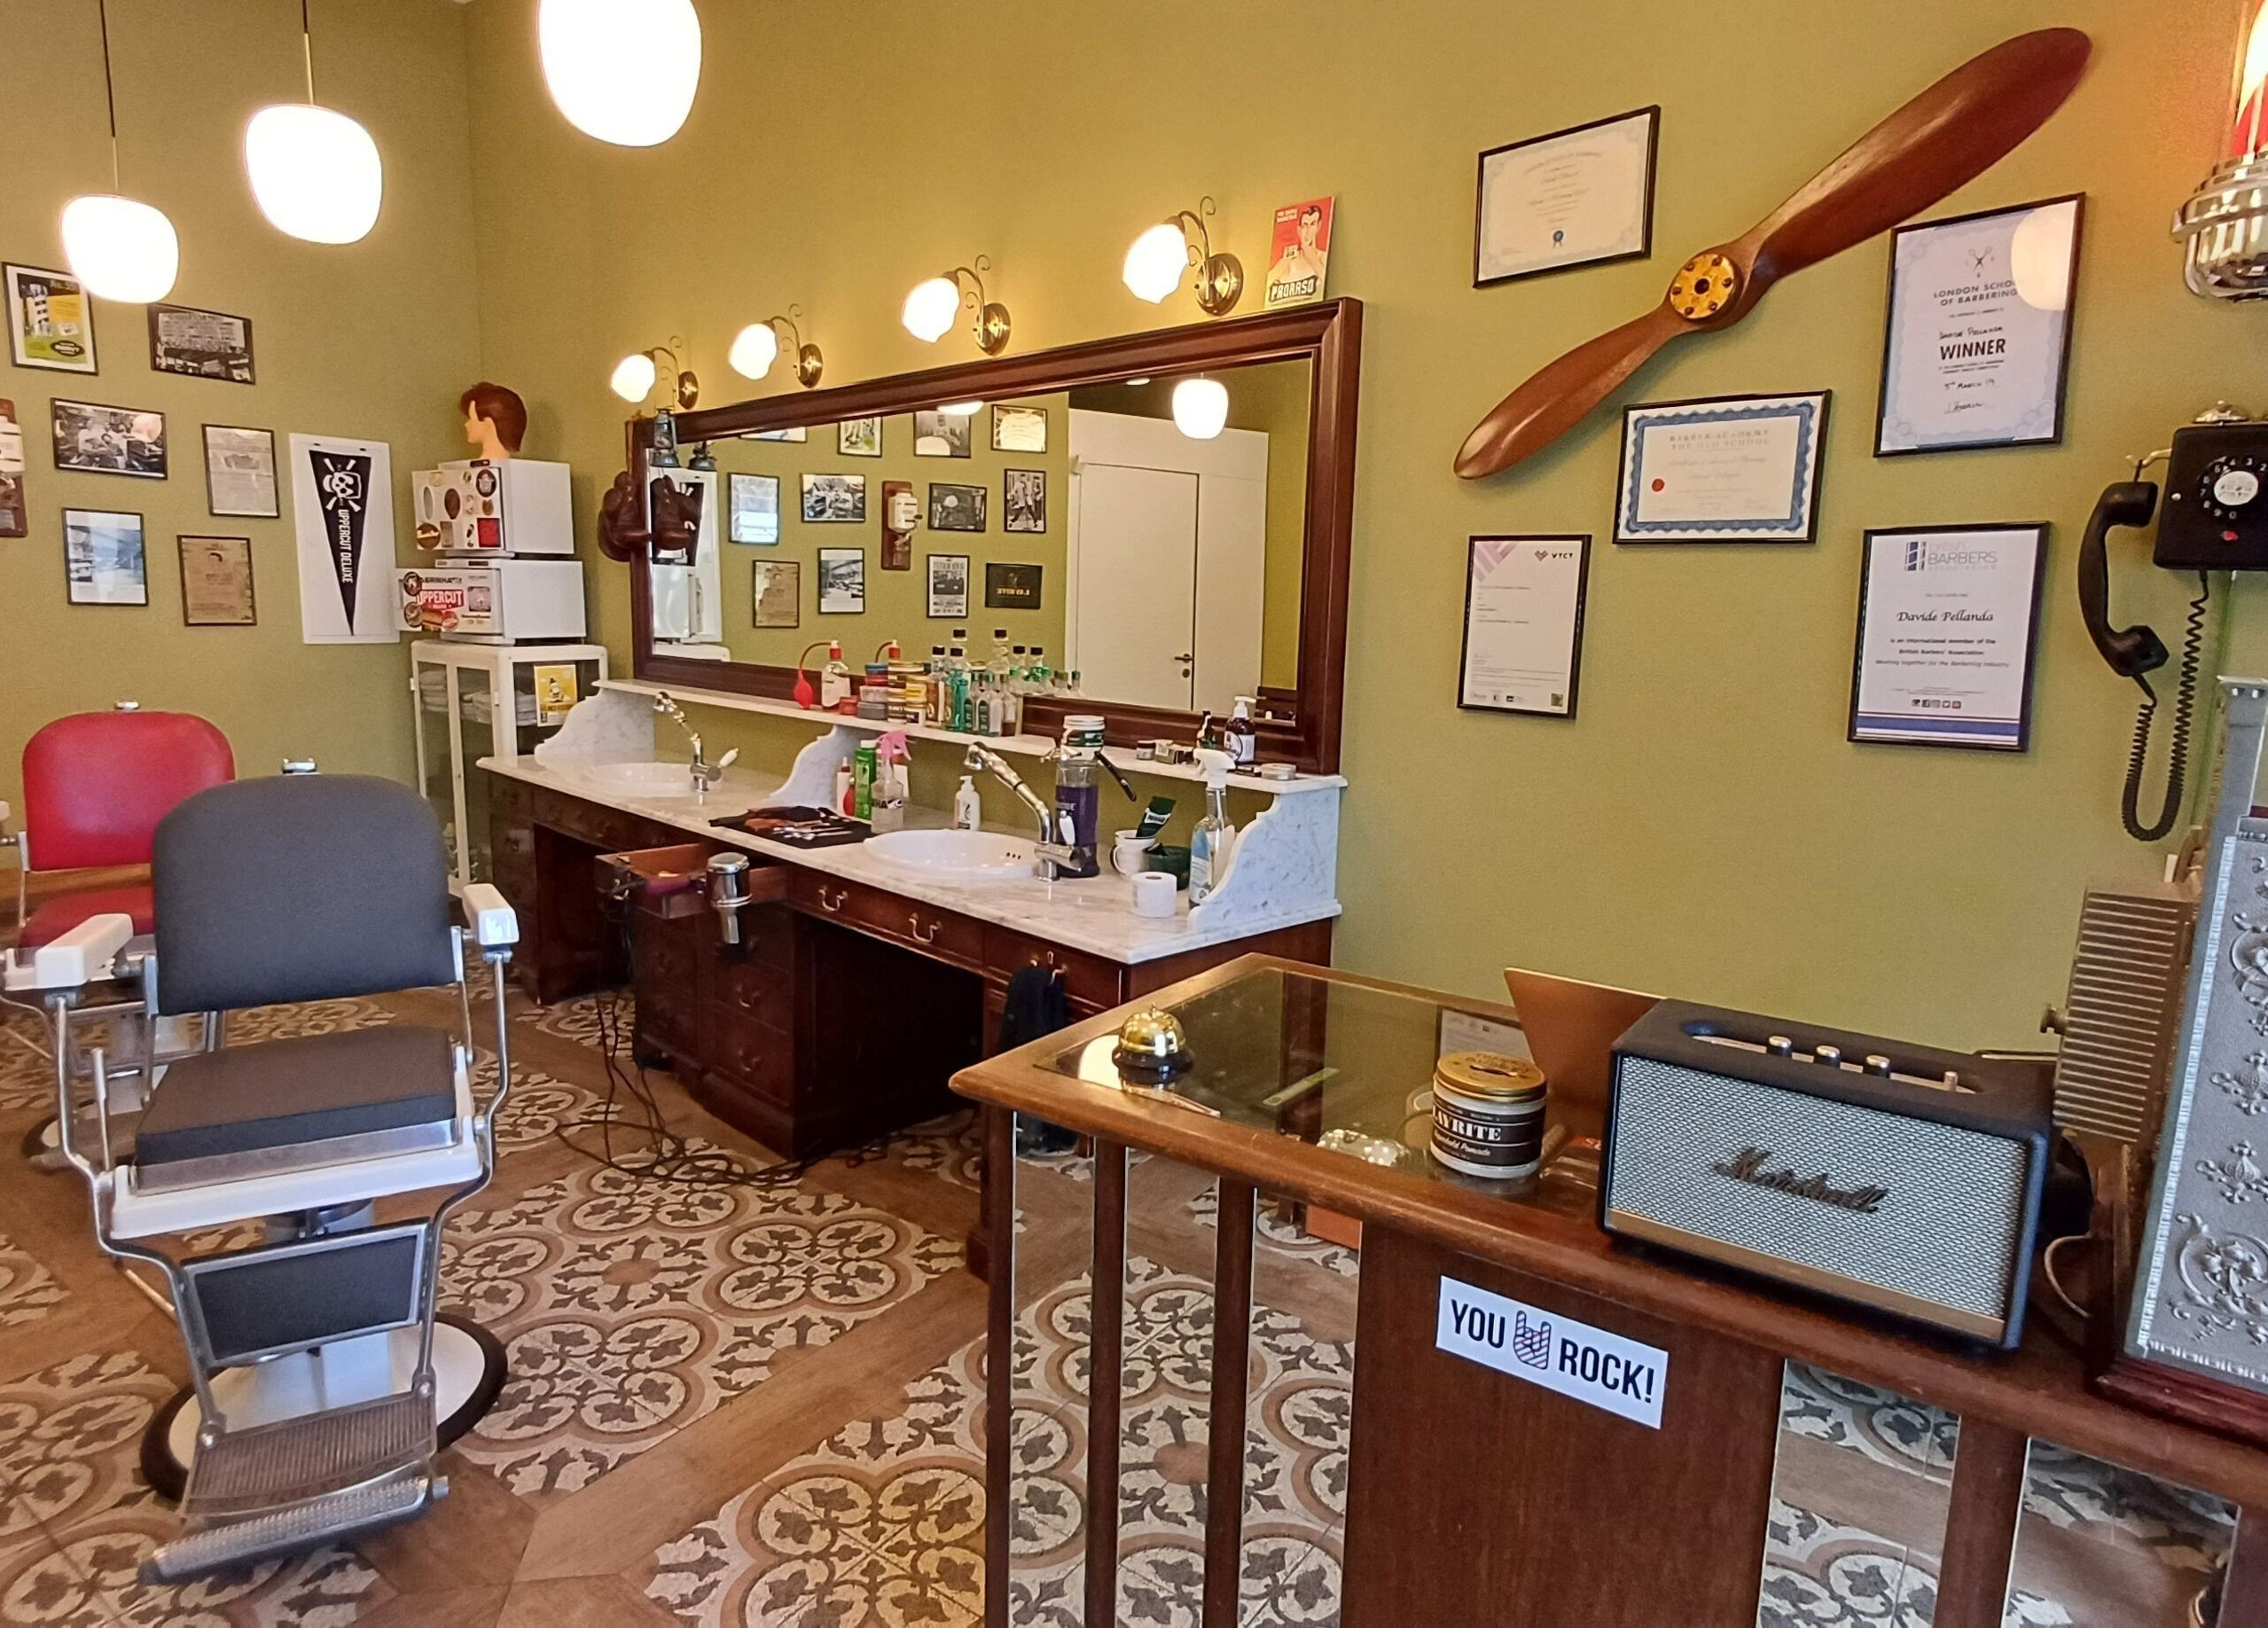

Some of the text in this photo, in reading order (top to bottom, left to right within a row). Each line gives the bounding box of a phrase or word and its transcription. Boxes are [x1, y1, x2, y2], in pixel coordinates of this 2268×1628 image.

[1271, 278, 1315, 301] PRORASO
[1934, 279, 2016, 298] LONDON SCHO
[1958, 288, 2018, 304] BARBERING
[1940, 339, 2006, 360] WINNER
[2246, 458, 2253, 466] 3
[2259, 463, 2267, 472] 2
[338, 509, 354, 583] UPPERCUT DELUXE
[1928, 552, 1998, 565] BARBERS
[418, 590, 463, 607] UPPERCUT
[1897, 609, 1994, 622] Davide Pellanda
[1714, 1147, 1889, 1214] Marshall
[1451, 1299, 1654, 1404] YOU ROCK!
